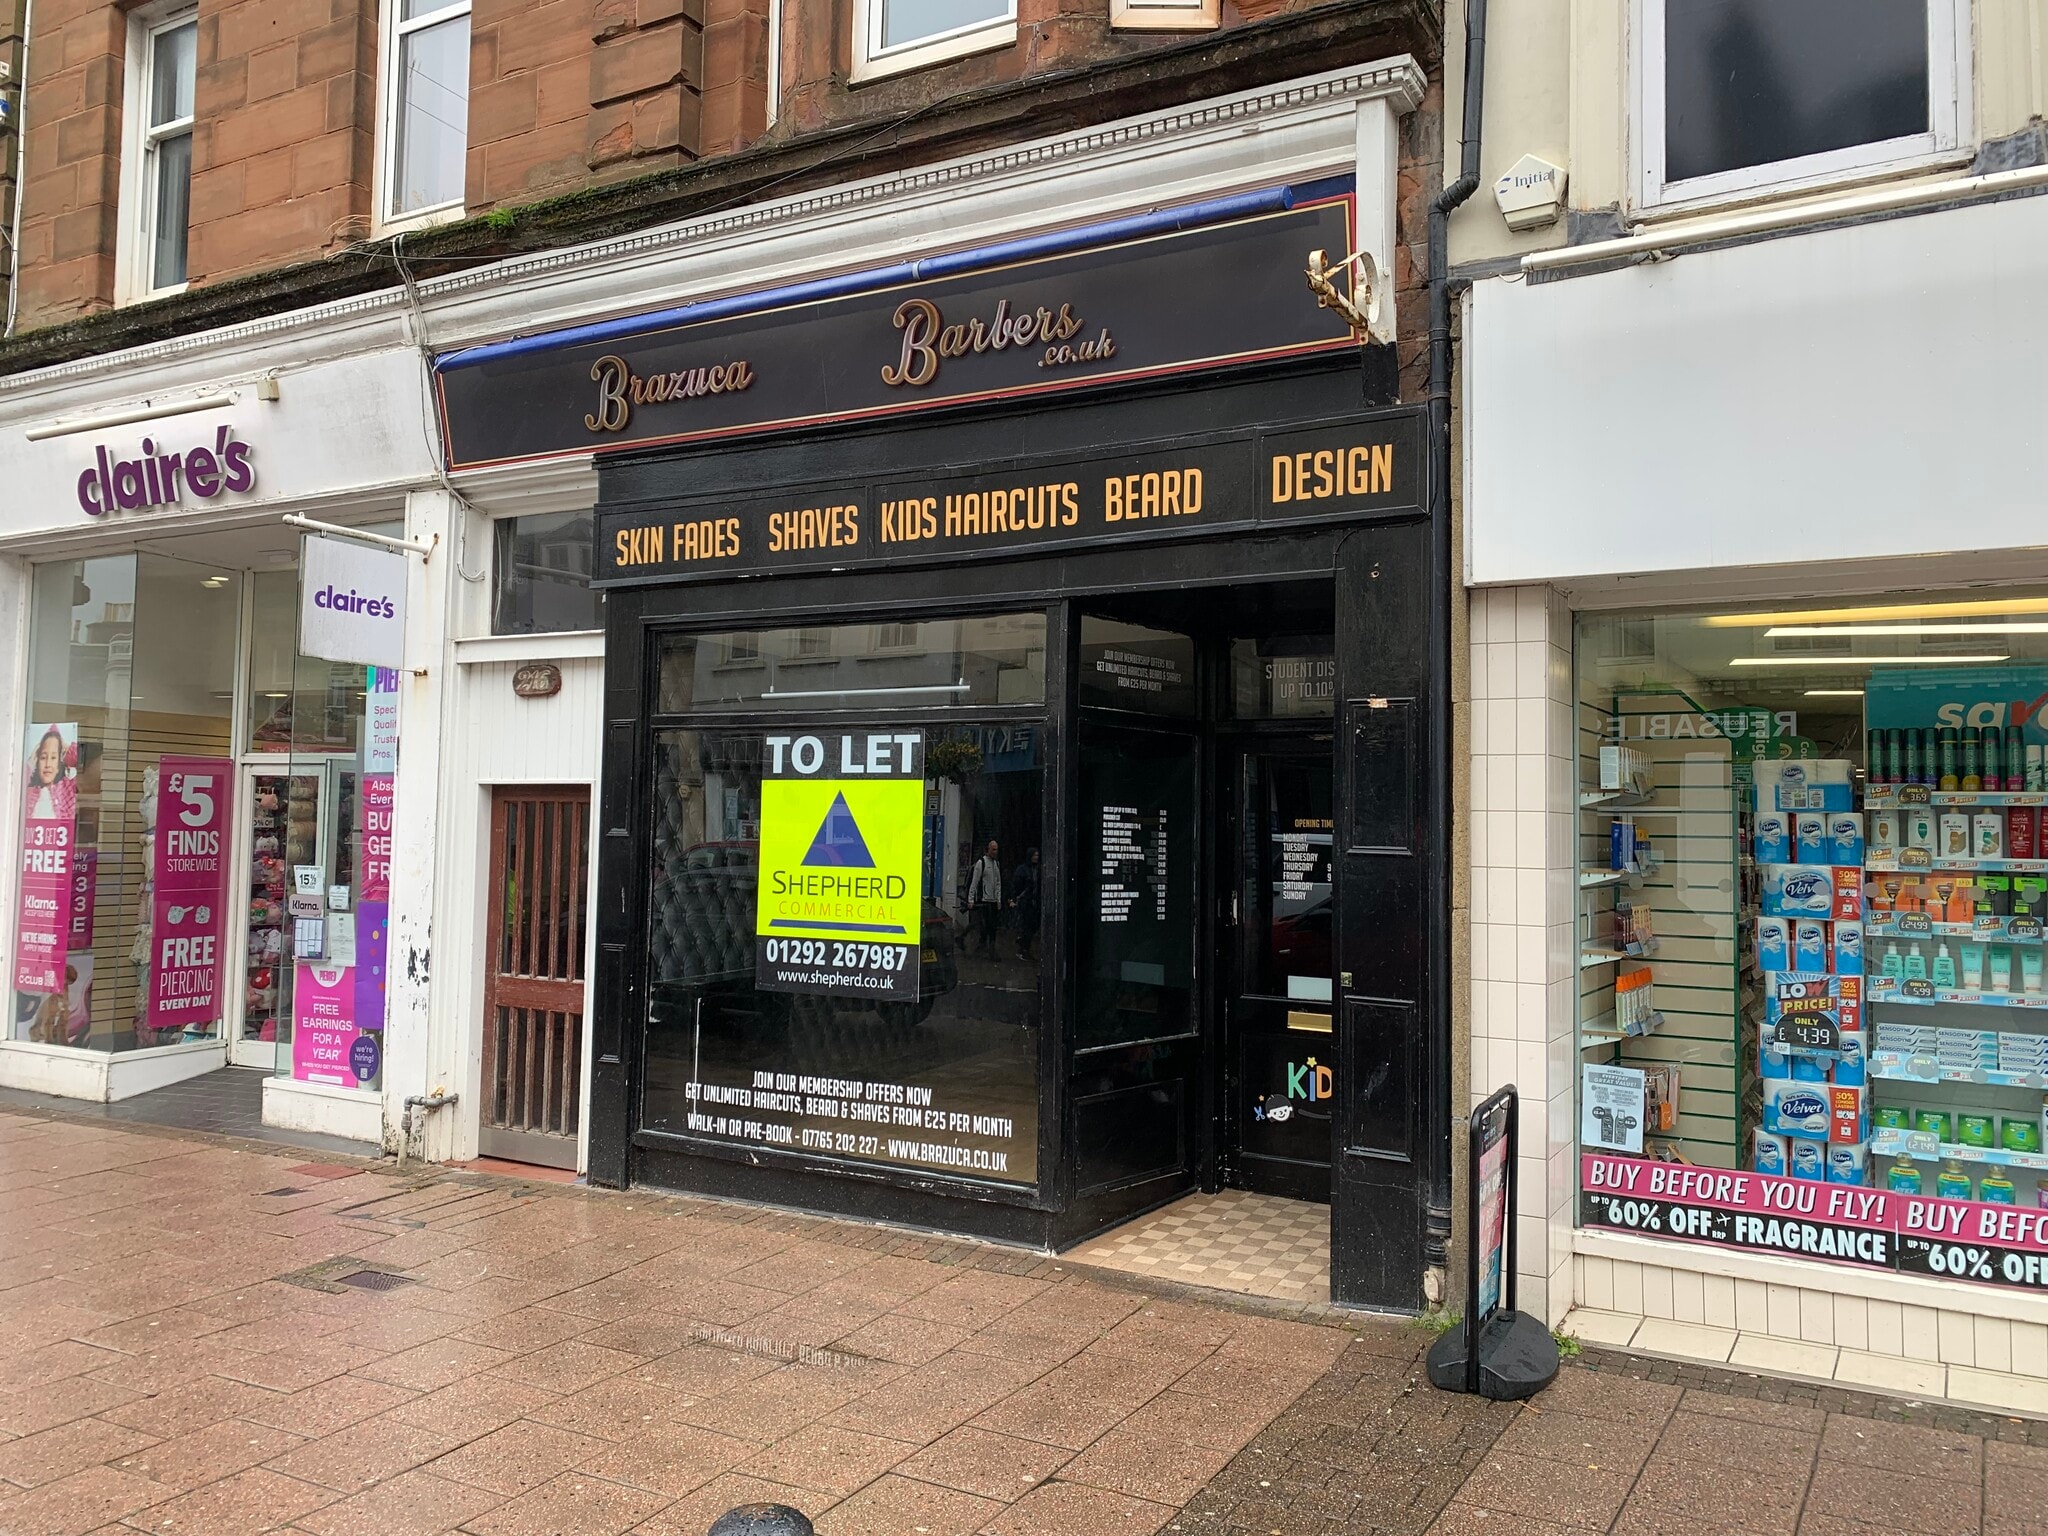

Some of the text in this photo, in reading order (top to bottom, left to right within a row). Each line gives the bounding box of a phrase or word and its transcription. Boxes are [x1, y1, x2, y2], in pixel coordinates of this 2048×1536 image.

[1514, 168, 1556, 187] Initial
[583, 297, 1084, 433] Brazuca Barbers
[77, 424, 255, 516] claire's
[616, 443, 1394, 567] SKIN FADES SHAVES KIDS HAIRCUTS BEARD DESIGN
[314, 585, 395, 619] claire's
[1265, 661, 1313, 680] STUDENT
[1280, 683, 1295, 698] UP
[1298, 682, 1312, 698] TO
[373, 750, 393, 760] Pros.
[765, 734, 921, 774] TO LET
[1294, 818, 1320, 828] OPENING
[34, 825, 44, 846] 3
[56, 826, 68, 847] 3
[167, 829, 220, 856] FINDS
[1283, 833, 1308, 842] MONDAY
[1283, 842, 1309, 852] TUESDAY
[23, 849, 67, 873] FREE
[167, 857, 218, 873] STOREWIDE
[1283, 852, 1319, 862] WEDNESDAY
[1283, 862, 1314, 871] THURSDAY
[771, 869, 907, 900] SHEPHERD
[1283, 871, 1304, 881] FRIDAY
[1283, 881, 1314, 891] SATURDAY
[1283, 890, 1307, 900] SUNDAY
[1787, 881, 1815, 896] Velv
[292, 899, 319, 911] Klarna.
[778, 901, 897, 921] COMMERCIAL
[161, 935, 216, 970] FREE
[766, 938, 826, 967] 01292
[831, 942, 908, 972] 267987
[159, 967, 213, 997] PIERCING
[776, 969, 894, 991] www.shepherd.co.uk
[159, 995, 212, 1012] EVERY DAY
[313, 1003, 339, 1016] FREE
[1783, 997, 1833, 1014] PRICE!
[302, 1017, 353, 1031] EARRINGS
[1794, 1017, 1819, 1026] ONLY
[312, 1033, 342, 1046] FOR A
[1797, 1027, 1830, 1045] 4.39
[752, 1071, 932, 1107] JOIN OUR MEMBERSHIP OFFERS NOW
[1835, 1092, 1855, 1100] 50%
[685, 1082, 702, 1099] GET
[703, 1084, 751, 1107] UNLIMITED
[753, 1091, 804, 1116] HAIRCUTS,
[806, 1097, 839, 1118] BEARD
[840, 1101, 848, 1119] &
[850, 1102, 890, 1125] SHAVES
[892, 1106, 922, 1128] FROM
[949, 1112, 970, 1133] PER
[972, 1115, 1013, 1139] MONTH
[1784, 1101, 1823, 1114] Velvet
[687, 1112, 1008, 1173] WALK-IN OR PRE-BOOK 07765 202 227 WWW.BRAZUCA.CO.UK
[1590, 1159, 1887, 1224] BUY BEFORE YOU FLY!
[1906, 1200, 1969, 1235] BUY
[1591, 1195, 1887, 1262] UP TO 60% OFF RRP FRAGRANCE
[1907, 1239, 1918, 1249] UP
[1919, 1241, 1930, 1250] TO
[1928, 1244, 1993, 1279] 60%
